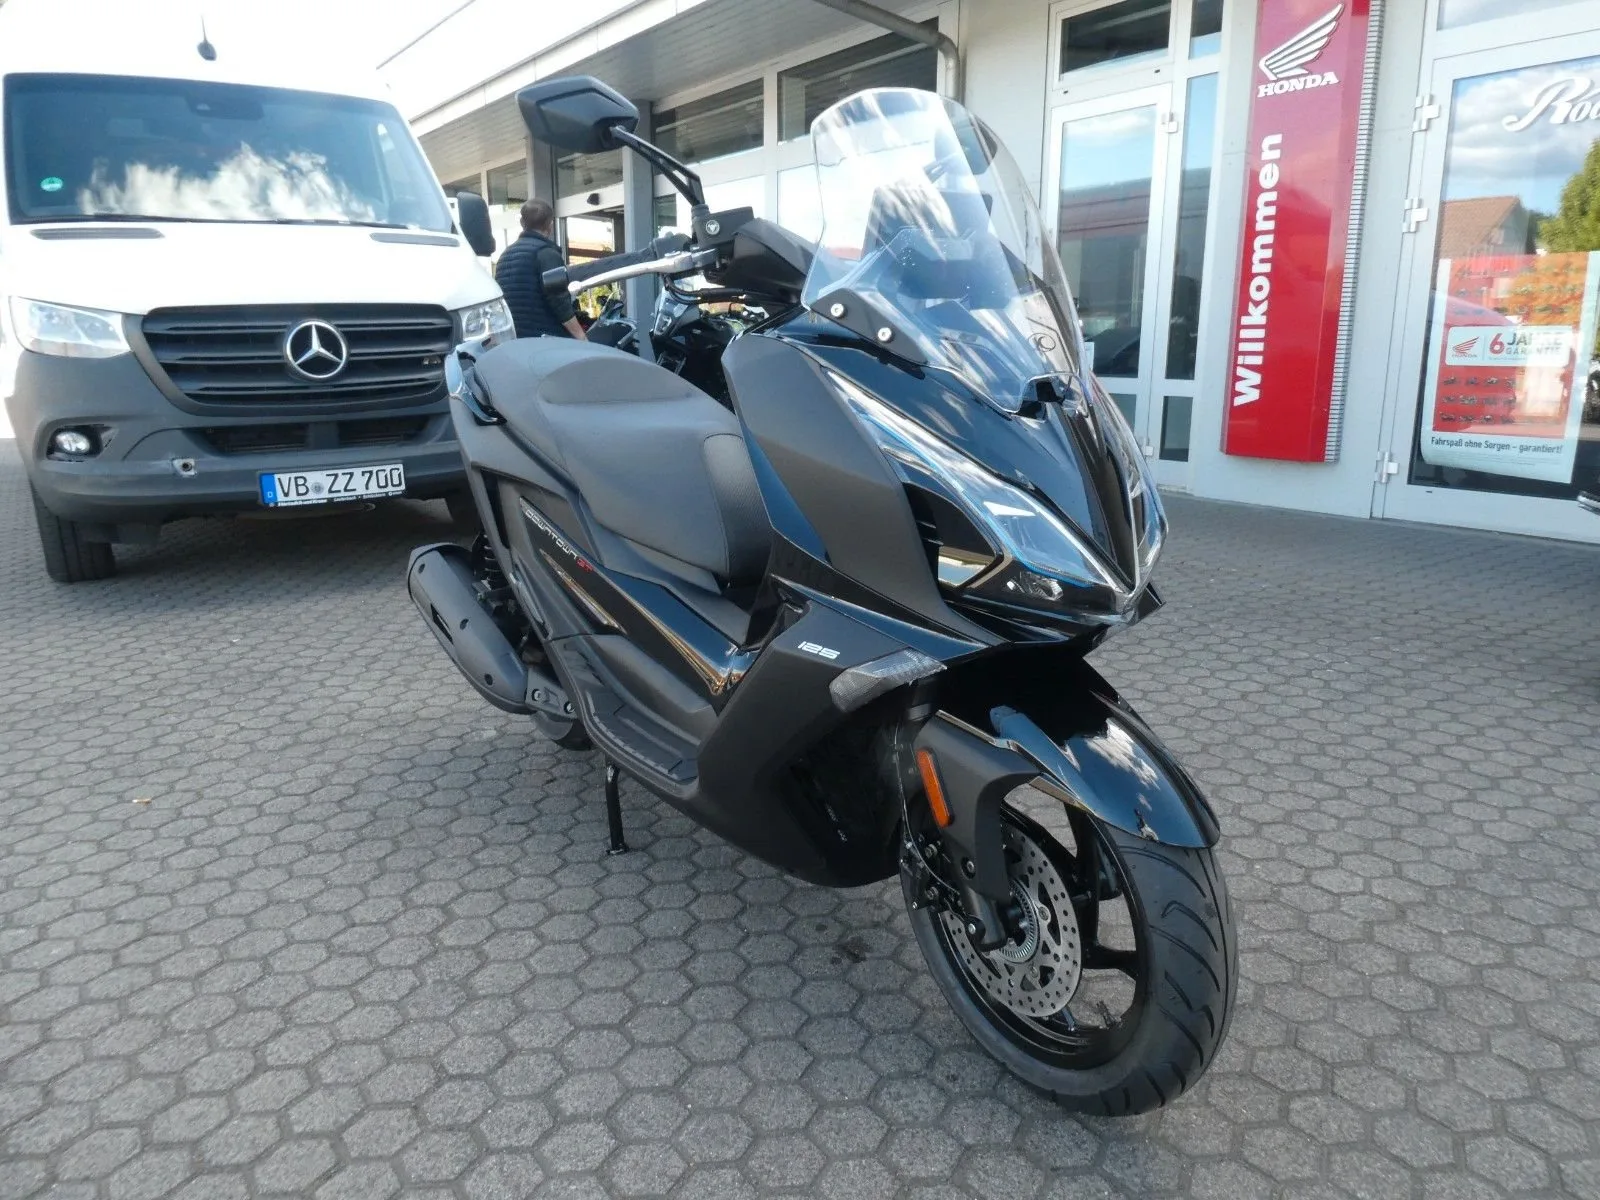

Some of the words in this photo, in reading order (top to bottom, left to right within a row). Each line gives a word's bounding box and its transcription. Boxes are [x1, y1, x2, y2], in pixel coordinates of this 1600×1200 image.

[1257, 71, 1339, 97] HONDA
[1233, 133, 1283, 407] Willkommen
[1489, 332, 1505, 355] 6
[1431, 436, 1463, 448] Fahrspaß
[1464, 439, 1483, 449] ohne
[1484, 440, 1511, 452] Sorgen
[1519, 443, 1563, 454] garantiert!
[278, 475, 310, 498] VB
[325, 471, 357, 494] ZZ
[361, 467, 403, 491] 700
[525, 509, 578, 560] DOWNTOWN
[797, 640, 841, 660] 125
